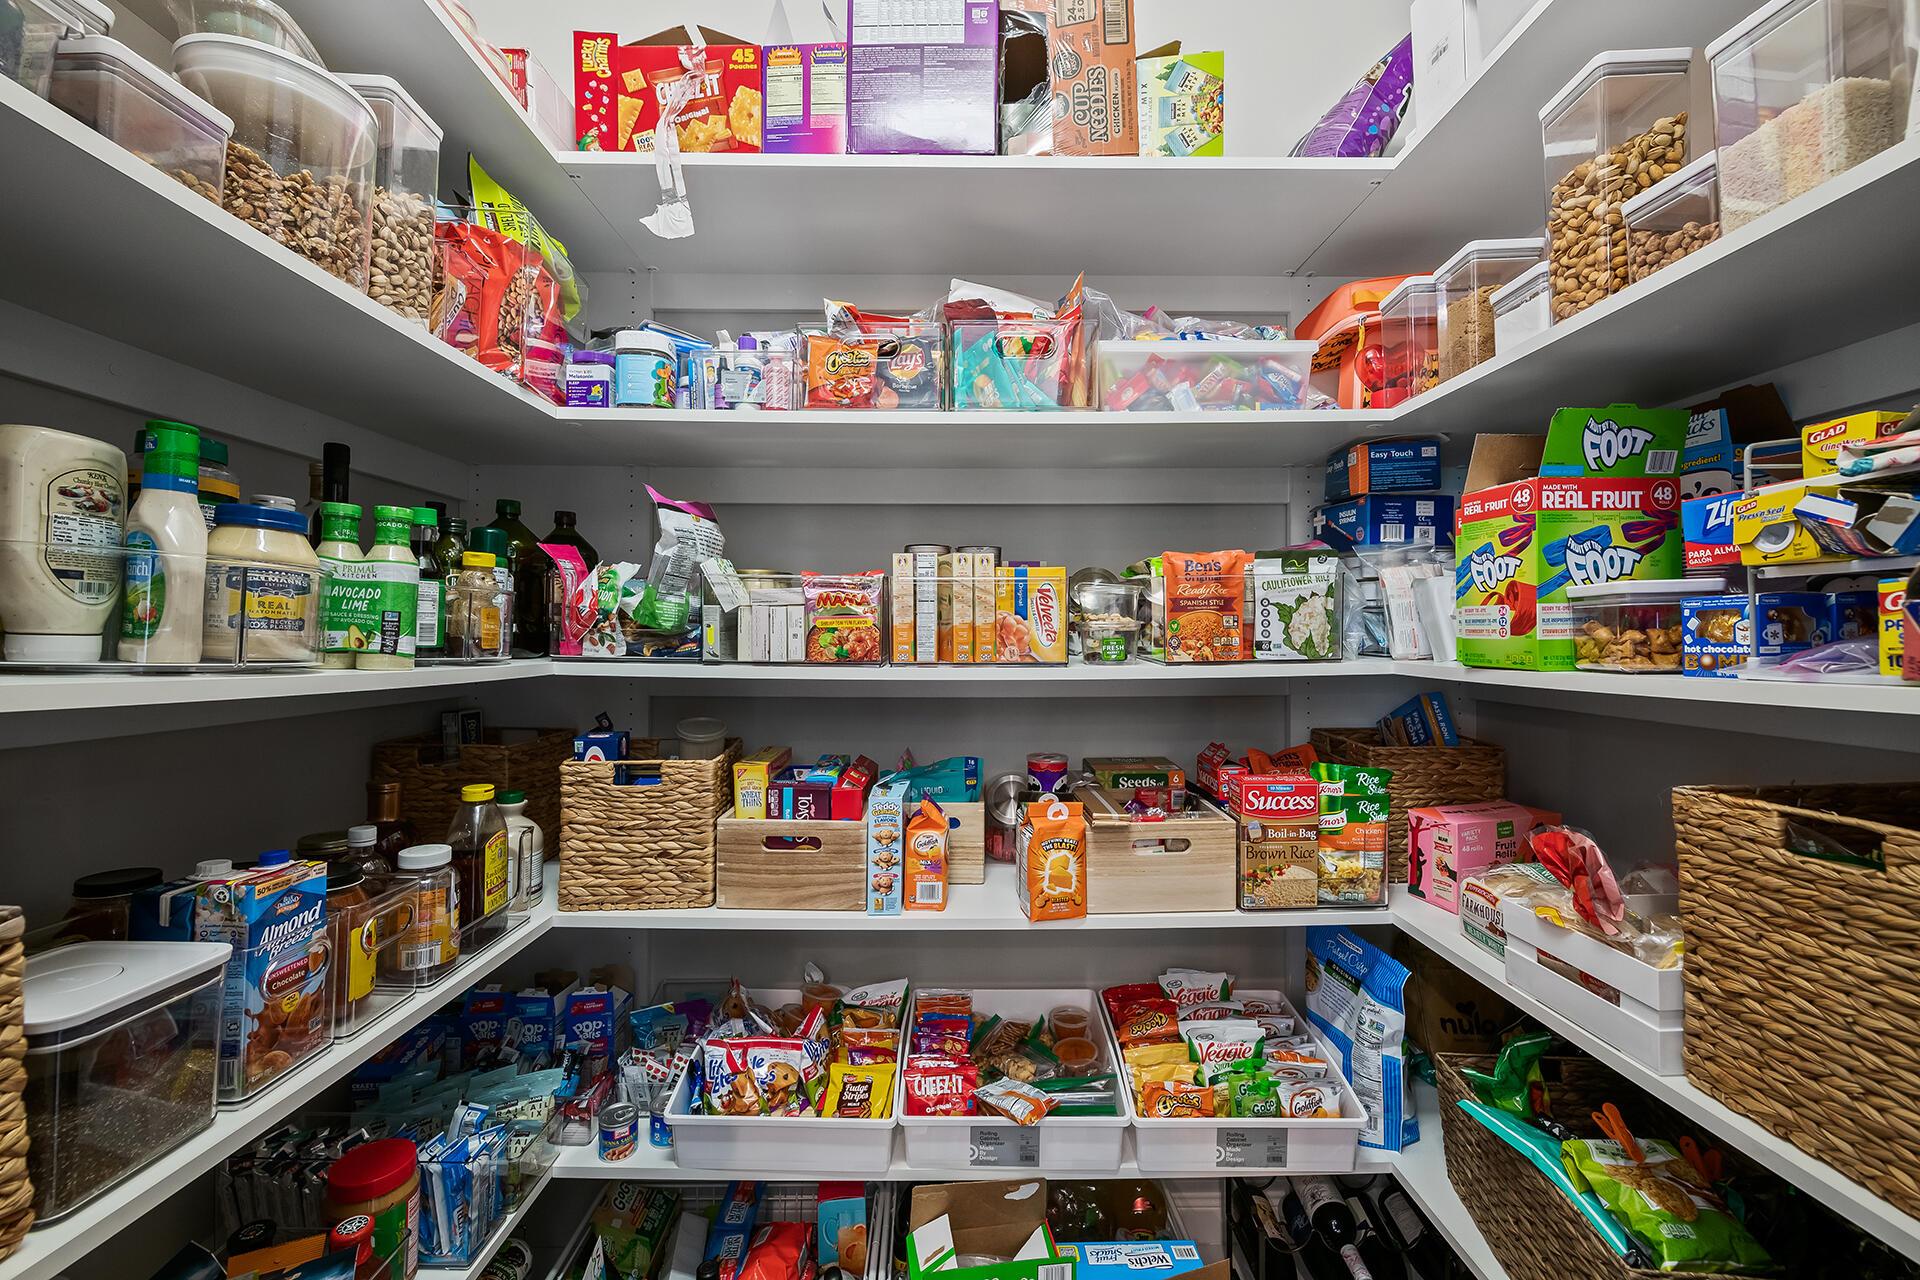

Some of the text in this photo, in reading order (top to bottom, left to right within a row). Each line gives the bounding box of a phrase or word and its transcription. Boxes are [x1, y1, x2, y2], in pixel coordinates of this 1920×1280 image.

[1067, 6, 1077, 21] 24
[731, 48, 755, 63] 45
[1072, 82, 1090, 126] CUP
[1088, 66, 1110, 143] NOODLES
[1112, 91, 1121, 135] CHICKEN
[891, 352, 923, 371] Lay's
[1588, 417, 1602, 433] FRUIT
[1601, 420, 1610, 431] BY
[1809, 424, 1846, 443] GLAD
[1370, 449, 1414, 459] Easy Touch
[1583, 428, 1655, 471] FOOT
[1513, 488, 1531, 503] 48
[1541, 491, 1644, 509] REAL FRUIT
[1653, 487, 1673, 500] 48
[1338, 508, 1357, 518] INSULIN
[1464, 498, 1509, 516] REAL FRUIT
[1737, 501, 1757, 513] GLAD
[1738, 505, 1786, 522] Press'n Seal
[1338, 516, 1357, 525] SYRINGE
[1568, 537, 1585, 554] FRUIT
[1583, 540, 1592, 549] BY
[1688, 549, 1712, 559] PARA
[1688, 556, 1713, 565] GALÓN
[342, 564, 376, 574] PRIMAL
[1184, 560, 1222, 572] Ben's
[1566, 547, 1642, 585] FOOT
[1471, 556, 1522, 592] FOOT
[1261, 575, 1312, 591] CAULIFLOWER
[331, 585, 381, 599] AVOCADO
[1176, 583, 1211, 599] Ready
[257, 600, 291, 610] REAL
[341, 599, 369, 611] LIME
[816, 592, 870, 608] MAMA
[1037, 588, 1058, 643] Velveeta
[1499, 618, 1506, 626] 12
[1684, 645, 1701, 653] hot
[1412, 711, 1425, 740] PASTA
[1432, 700, 1450, 741] PASTA RONI
[1118, 776, 1157, 789] Seeds
[1173, 775, 1179, 783] 6
[1355, 772, 1380, 786] Rice
[740, 791, 762, 799] WHEAT
[1319, 785, 1342, 794] Knorr
[741, 799, 762, 808] THINS
[872, 801, 898, 811] Teddy
[1246, 790, 1316, 811] Success
[1356, 800, 1380, 814] Rice
[1268, 828, 1317, 840] Boil-in-Bag
[1354, 827, 1382, 835] Chicken
[1461, 829, 1481, 837] VARIETY
[916, 839, 939, 850] Goldfish
[1042, 843, 1077, 851] THE BLAST!
[1246, 844, 1316, 860] Brown Rice
[1471, 844, 1484, 852] rolls
[1495, 841, 1517, 850] Fruit
[1495, 850, 1517, 859] Rolls
[256, 884, 272, 896] 50%
[1461, 892, 1504, 928] FARMHOUS
[260, 900, 323, 945] Almond
[269, 926, 313, 961] Breeze
[268, 957, 309, 981] UNSWEETENED
[1332, 964, 1356, 984] ORIGINAL
[271, 970, 306, 991] Chocolate
[1169, 987, 1219, 1005] Veggie
[1131, 1012, 1169, 1035] Cheetos
[1198, 1042, 1253, 1065] Veggie
[845, 1084, 869, 1093] Fudge
[914, 1074, 964, 1096] CHEEZ-IT
[842, 1091, 869, 1102] Stripes
[1157, 1094, 1201, 1116] Cheetos
[1251, 1100, 1275, 1115] GoGo
[1294, 1097, 1323, 1115] Goldfish
[1089, 1248, 1123, 1264] Fruit Snacks
[1127, 1254, 1170, 1268] Welch's
